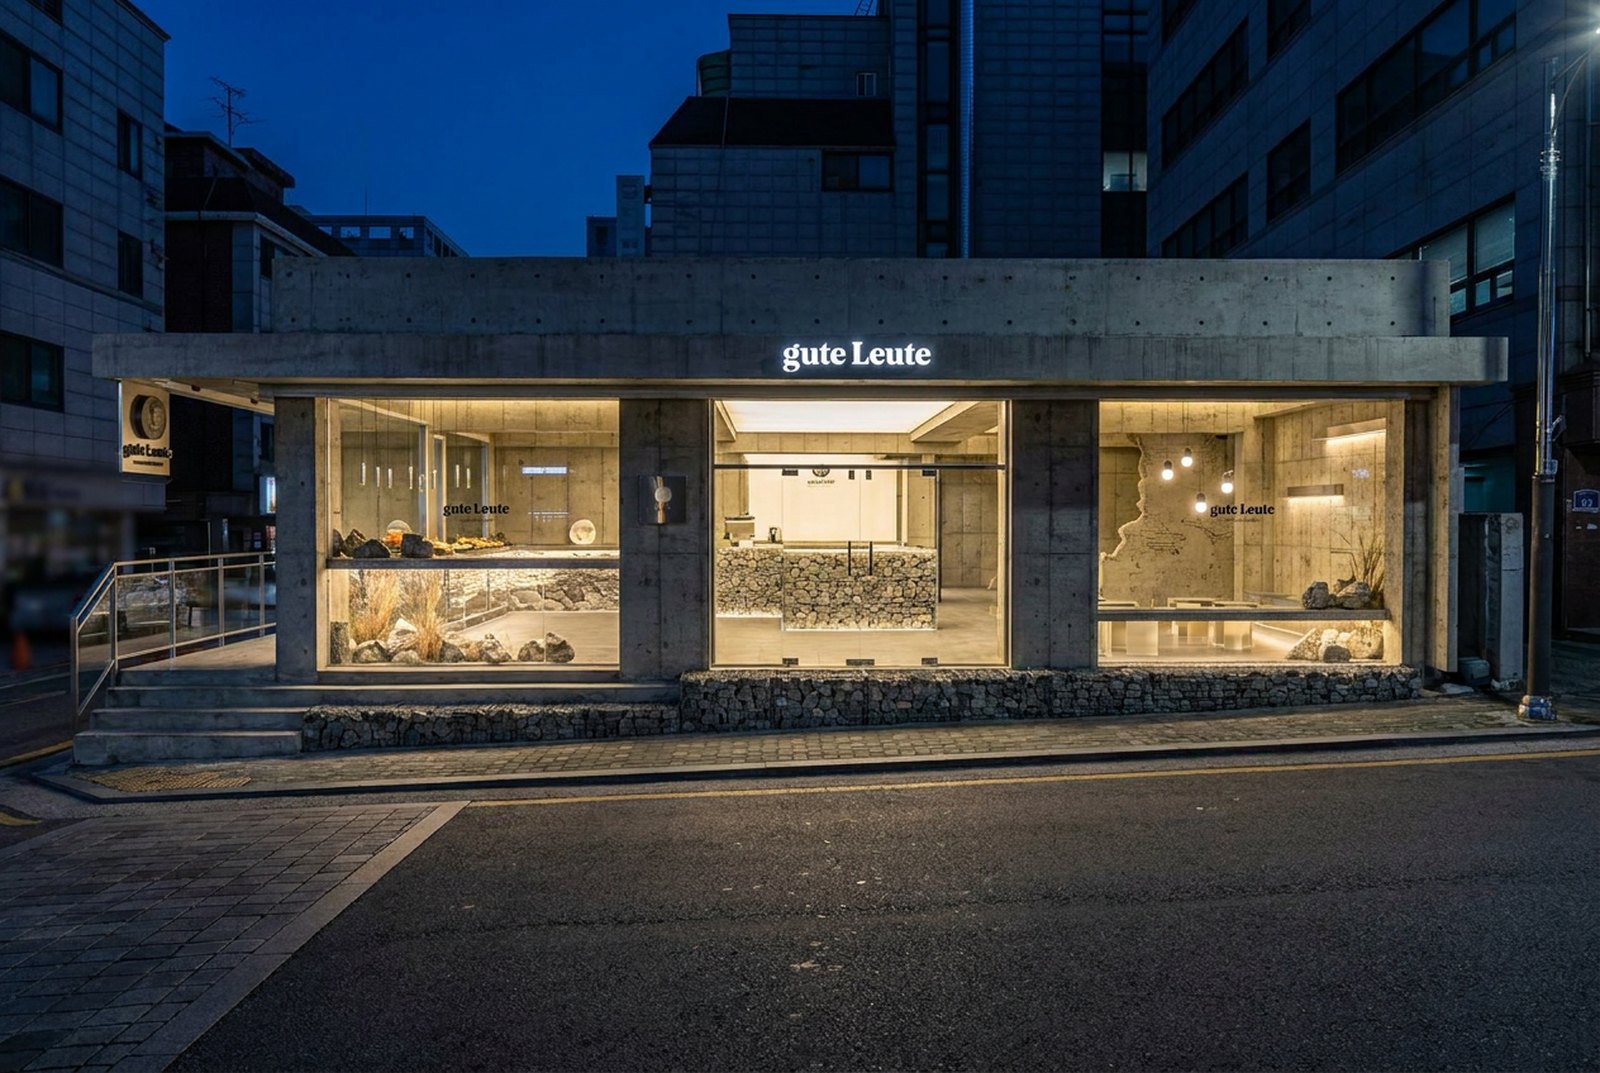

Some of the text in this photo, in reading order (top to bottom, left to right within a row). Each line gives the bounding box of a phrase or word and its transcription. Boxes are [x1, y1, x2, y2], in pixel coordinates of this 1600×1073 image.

[782, 341, 931, 372] gute Leute
[474, 503, 510, 514] Leute
[1210, 504, 1238, 518] gute
